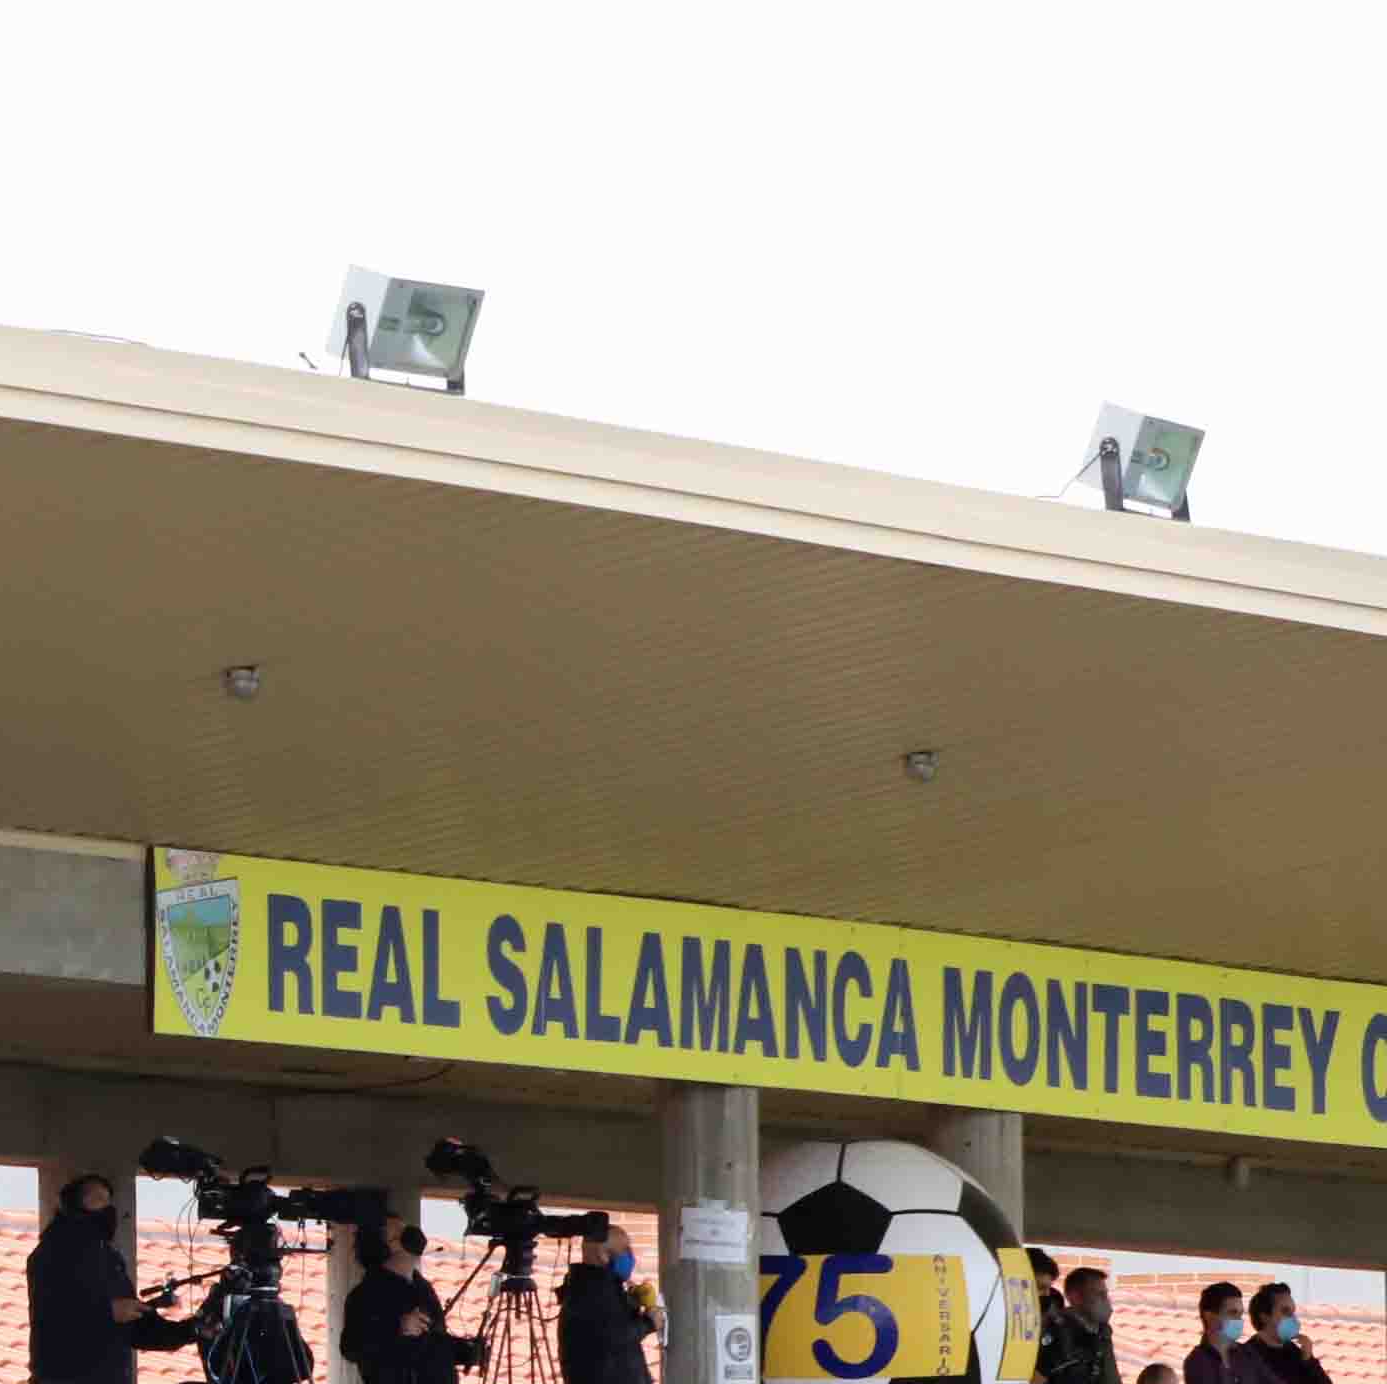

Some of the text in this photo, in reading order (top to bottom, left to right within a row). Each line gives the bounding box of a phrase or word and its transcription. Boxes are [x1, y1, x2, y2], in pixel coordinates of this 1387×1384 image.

[268, 893, 460, 1030] REAL
[486, 913, 918, 1073] SALAMANCA
[942, 967, 1340, 1117] MONTERREY
